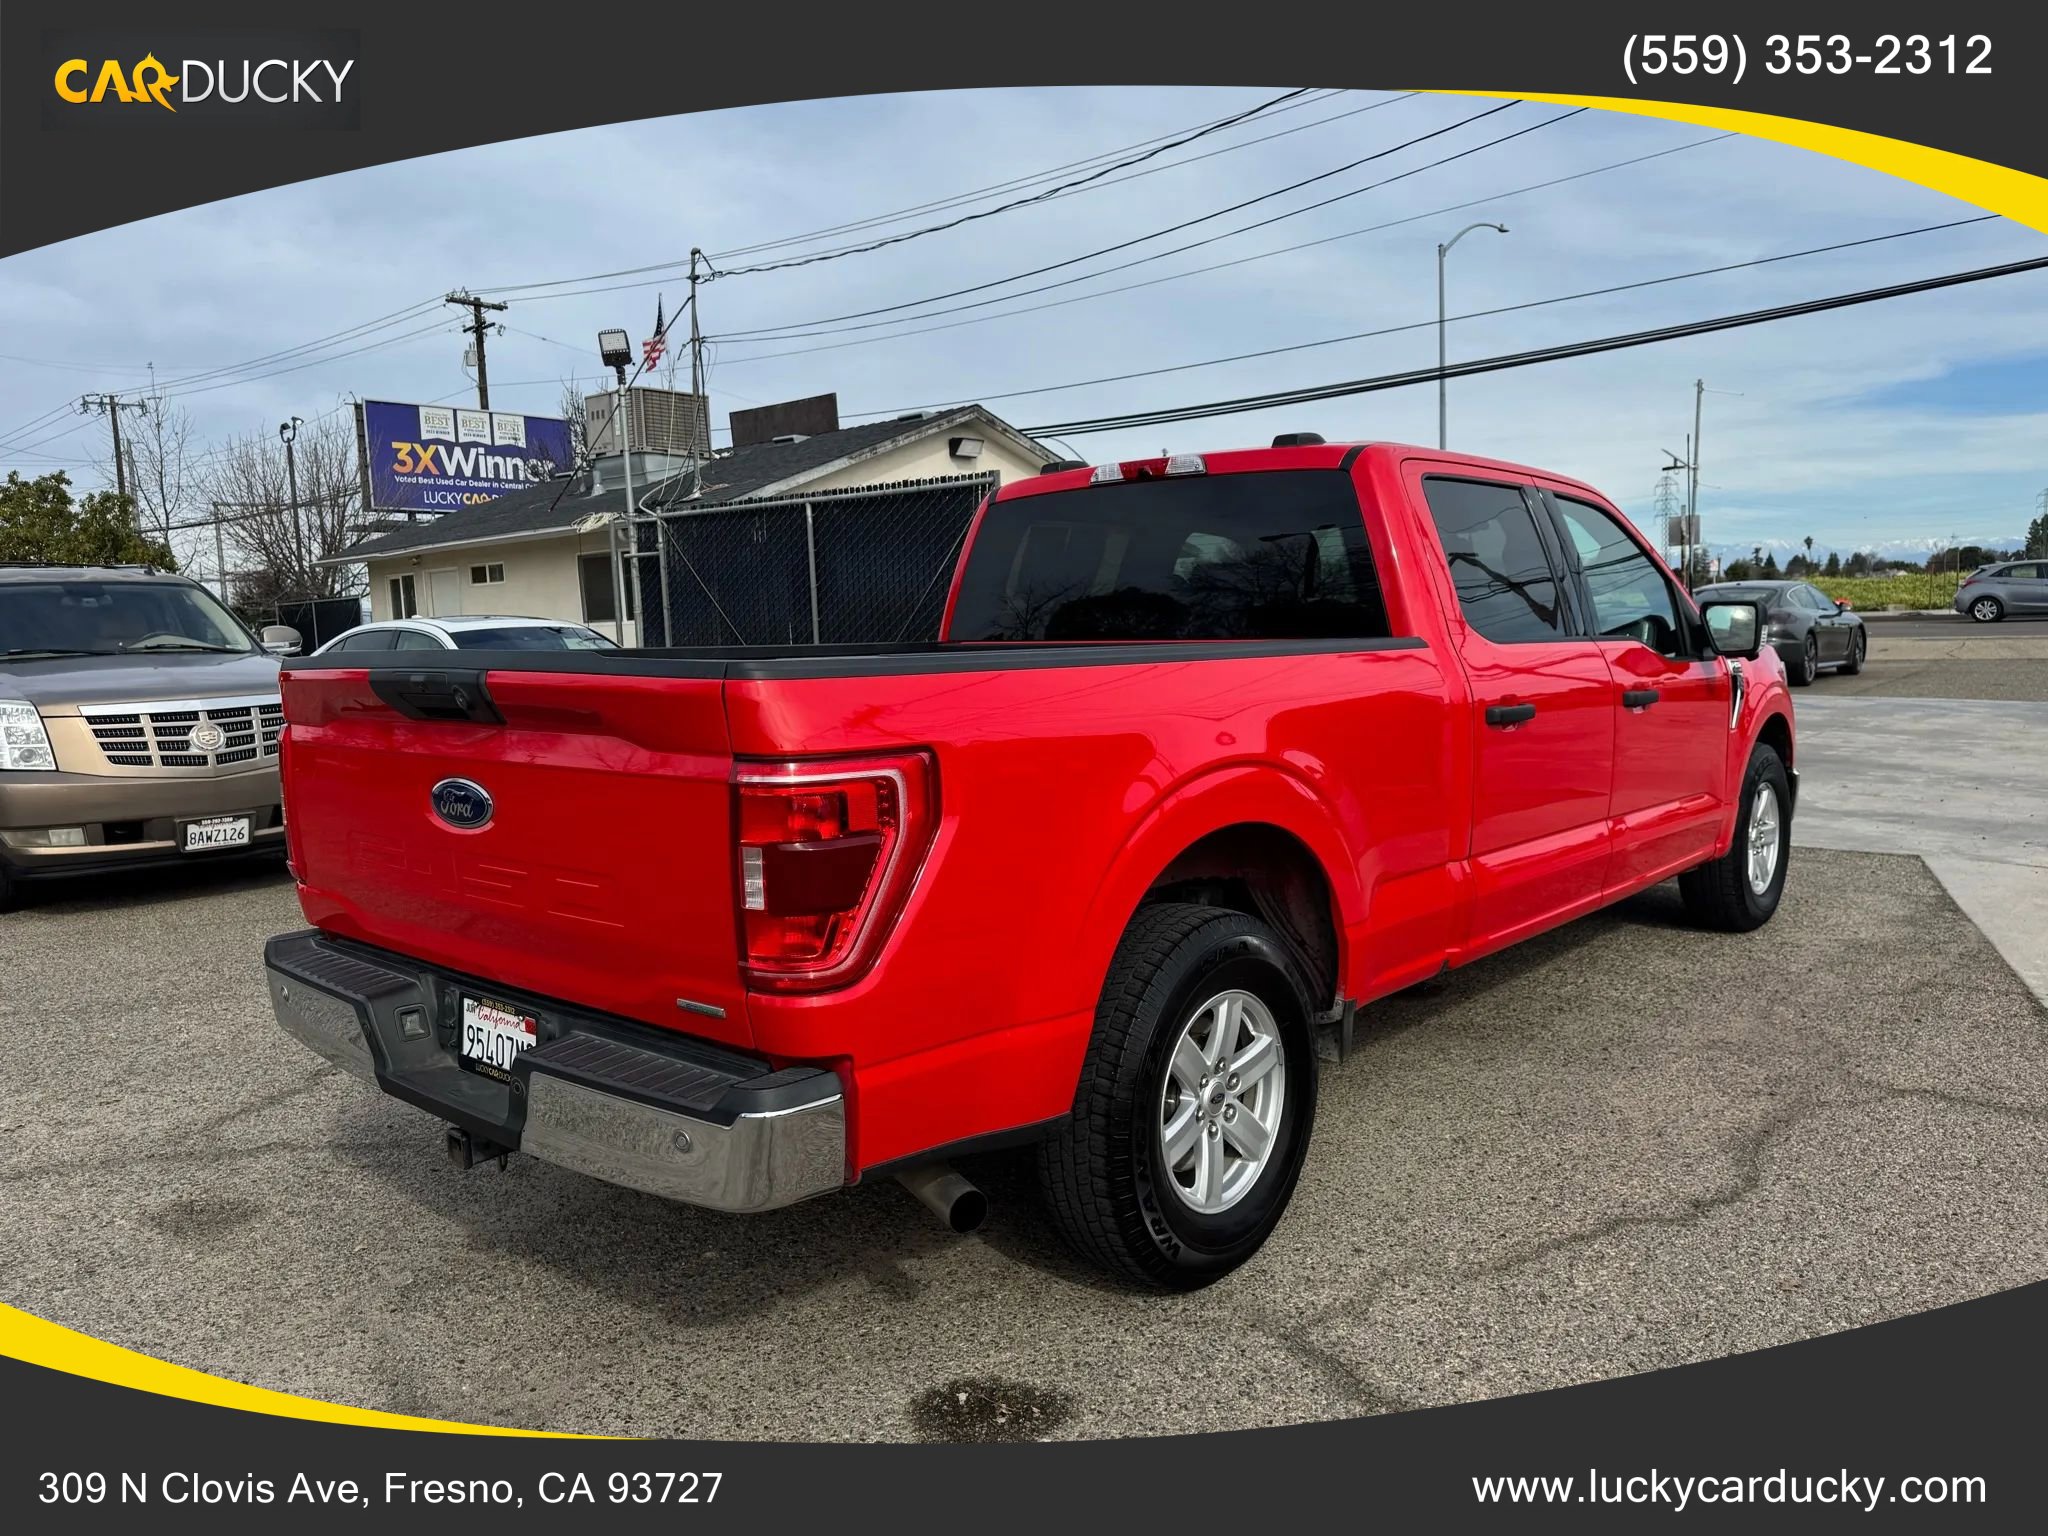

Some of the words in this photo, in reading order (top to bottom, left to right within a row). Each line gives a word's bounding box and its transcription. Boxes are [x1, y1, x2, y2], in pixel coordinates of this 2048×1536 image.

[424, 415, 450, 426] BEST
[462, 419, 487, 429] BEST
[497, 422, 521, 432] BEST
[395, 475, 417, 483] Voted
[418, 476, 434, 484] Best
[436, 478, 453, 486] Used
[469, 480, 491, 488] Dealer
[500, 482, 524, 490] Central
[441, 788, 474, 817] Ford
[189, 827, 245, 845] 8AWZ126
[477, 1005, 520, 1030] California
[467, 1024, 534, 1070] 95407
[475, 1063, 511, 1082] LUCKYCARDUCK
